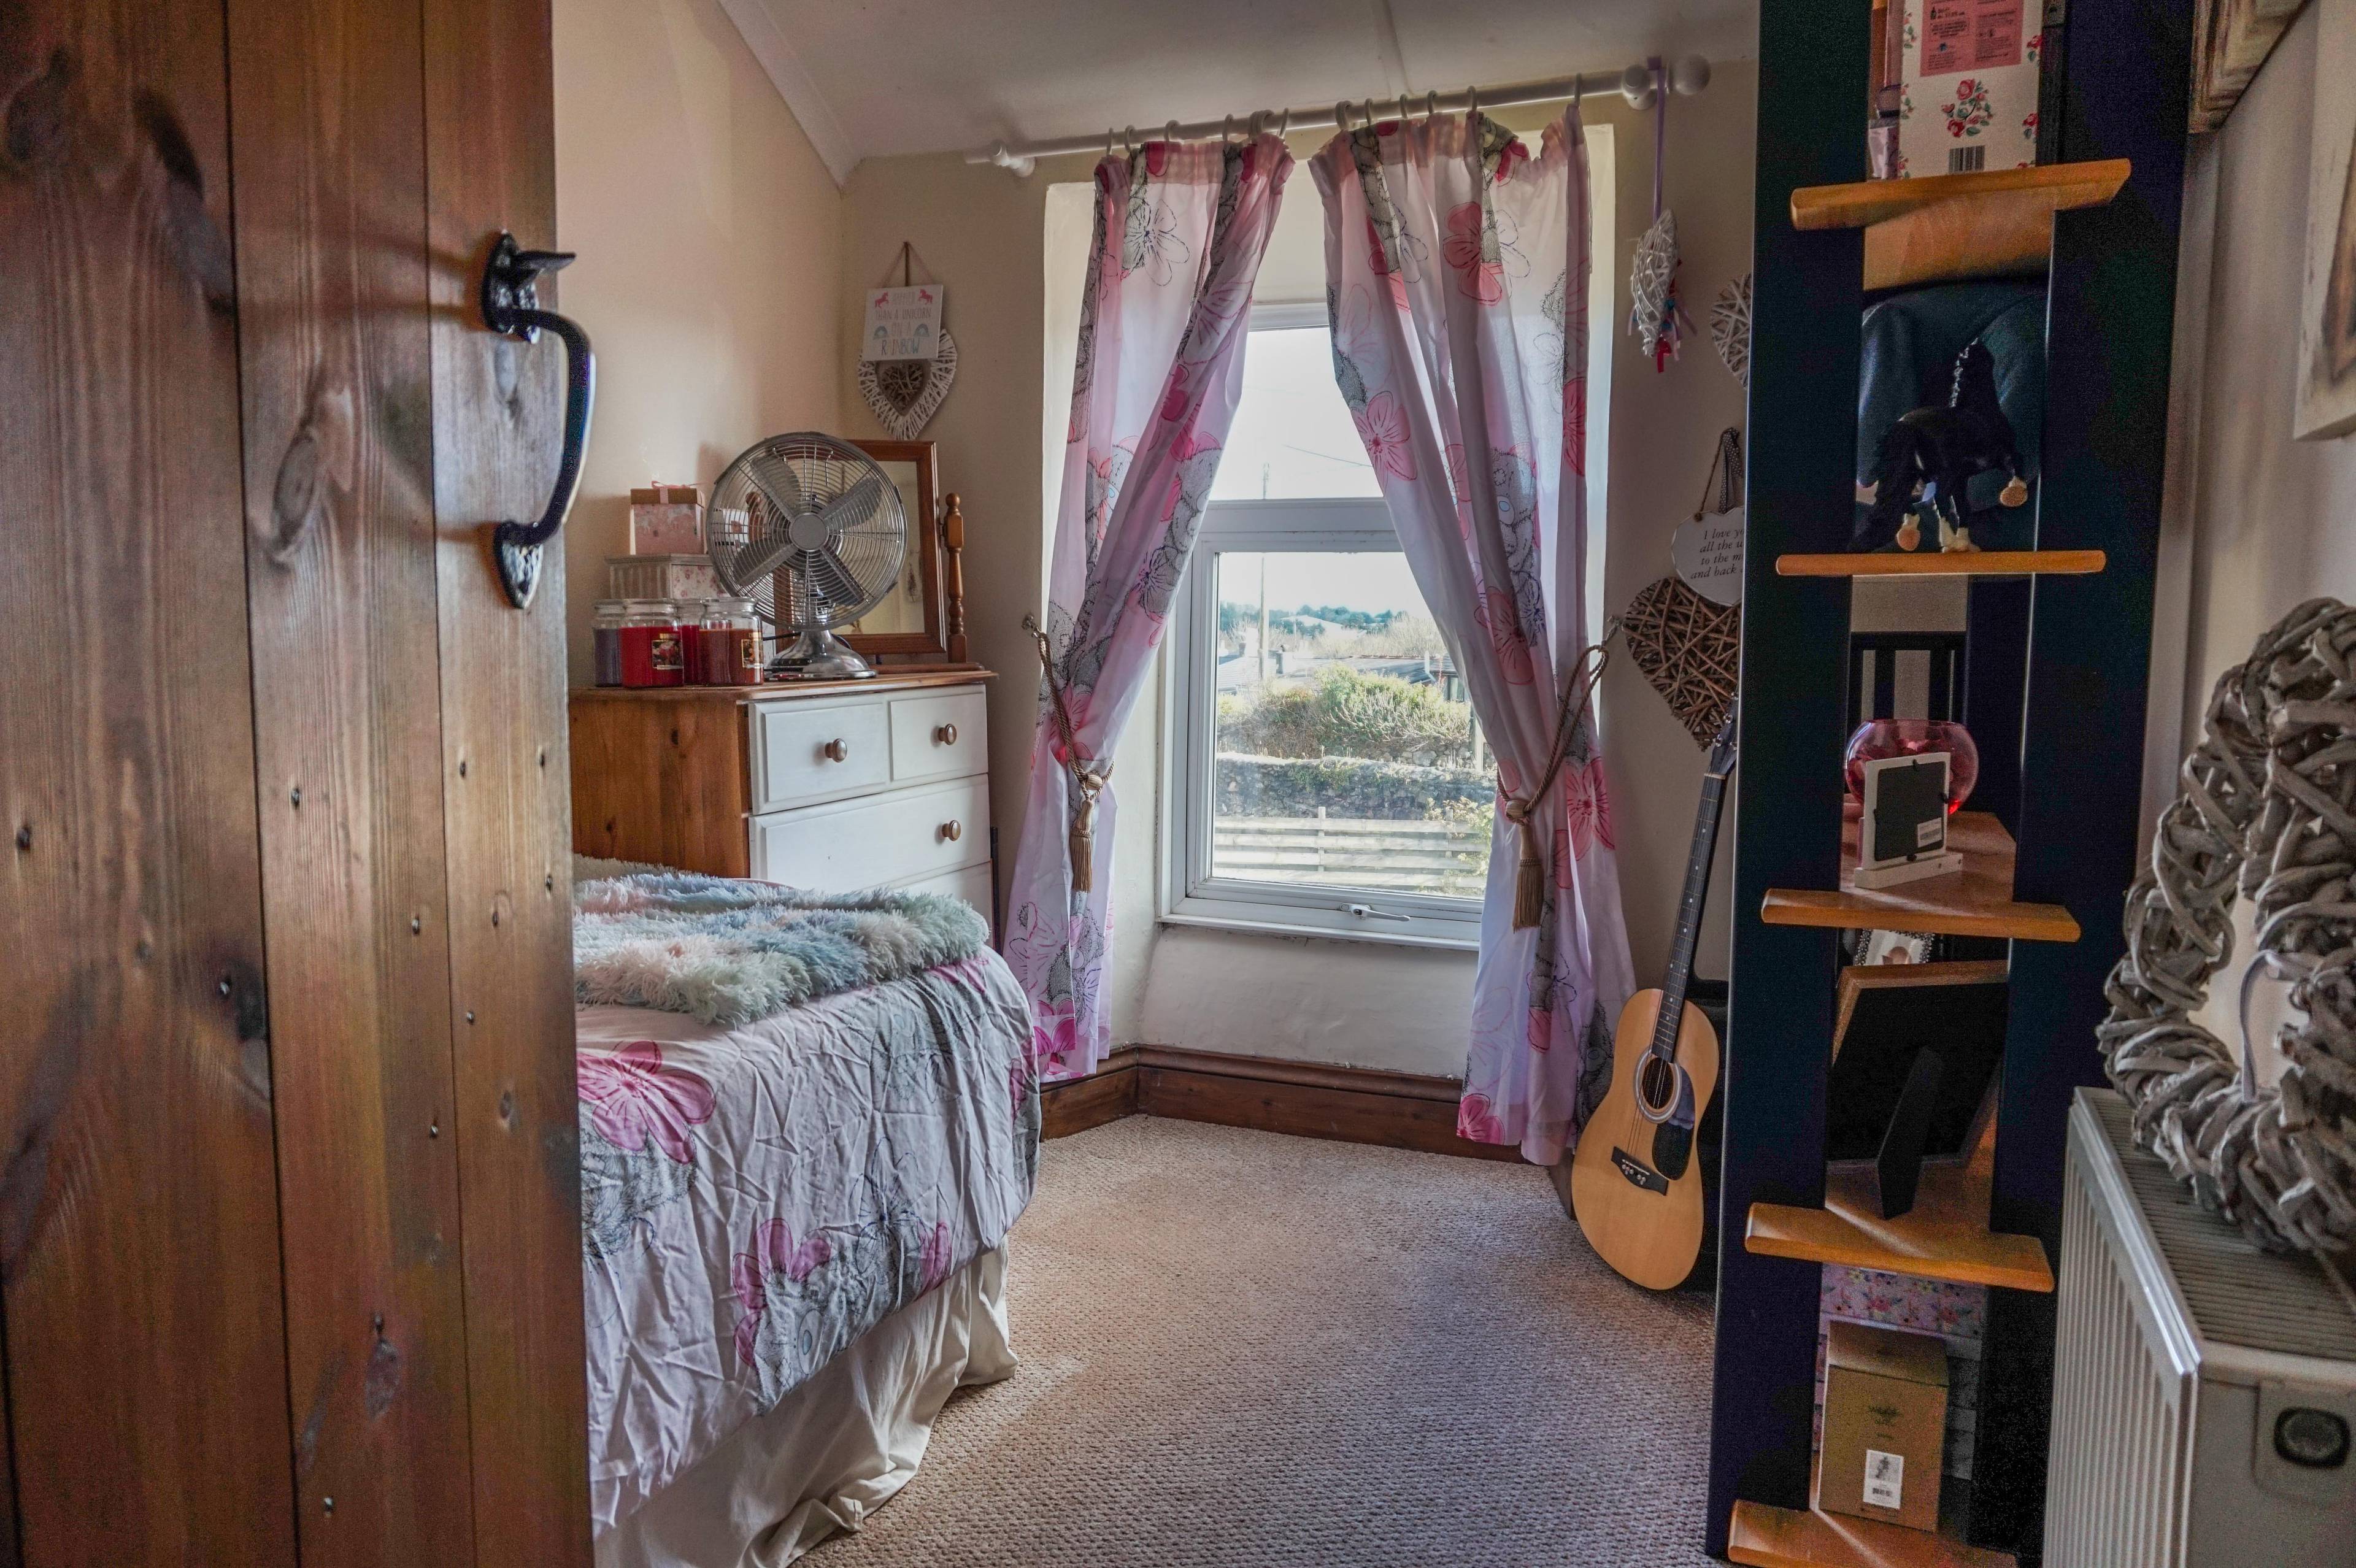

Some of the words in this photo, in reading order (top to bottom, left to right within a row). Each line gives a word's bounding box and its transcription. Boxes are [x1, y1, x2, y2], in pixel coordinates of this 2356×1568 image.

[876, 309, 893, 320] THAN
[894, 309, 899, 320] A
[903, 307, 931, 320] UNICORN
[1712, 529, 1730, 539] love
[1734, 529, 1745, 539] yo
[1700, 541, 1714, 553] all
[1718, 539, 1733, 550] the
[1714, 553, 1729, 564] the
[1690, 566, 1712, 579] and
[1714, 564, 1737, 576] back
